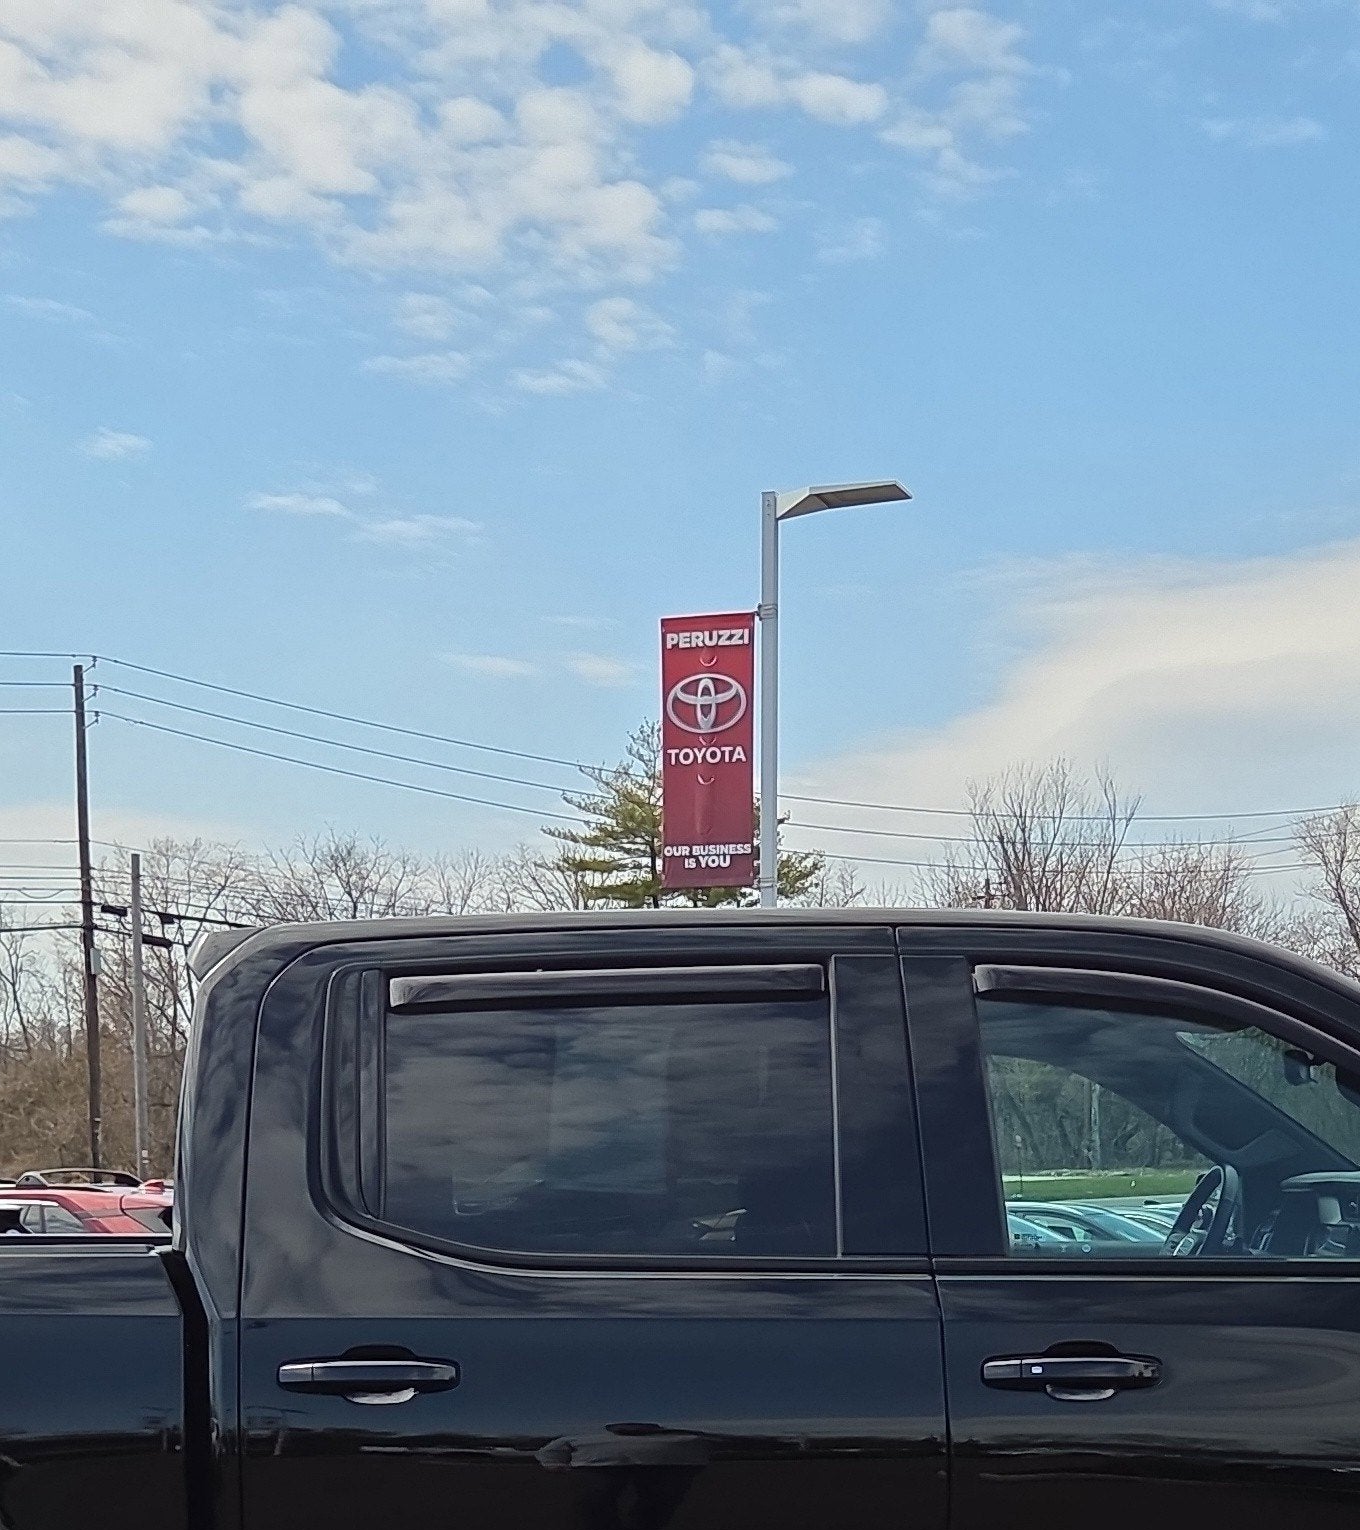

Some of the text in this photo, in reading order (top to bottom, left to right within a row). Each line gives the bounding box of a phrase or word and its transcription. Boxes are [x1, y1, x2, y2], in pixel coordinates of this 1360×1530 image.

[666, 628, 750, 650] PERUZZI
[666, 745, 747, 765] TOYOTA
[663, 843, 751, 857] OUR BUSINESS
[698, 854, 731, 868] YOU
